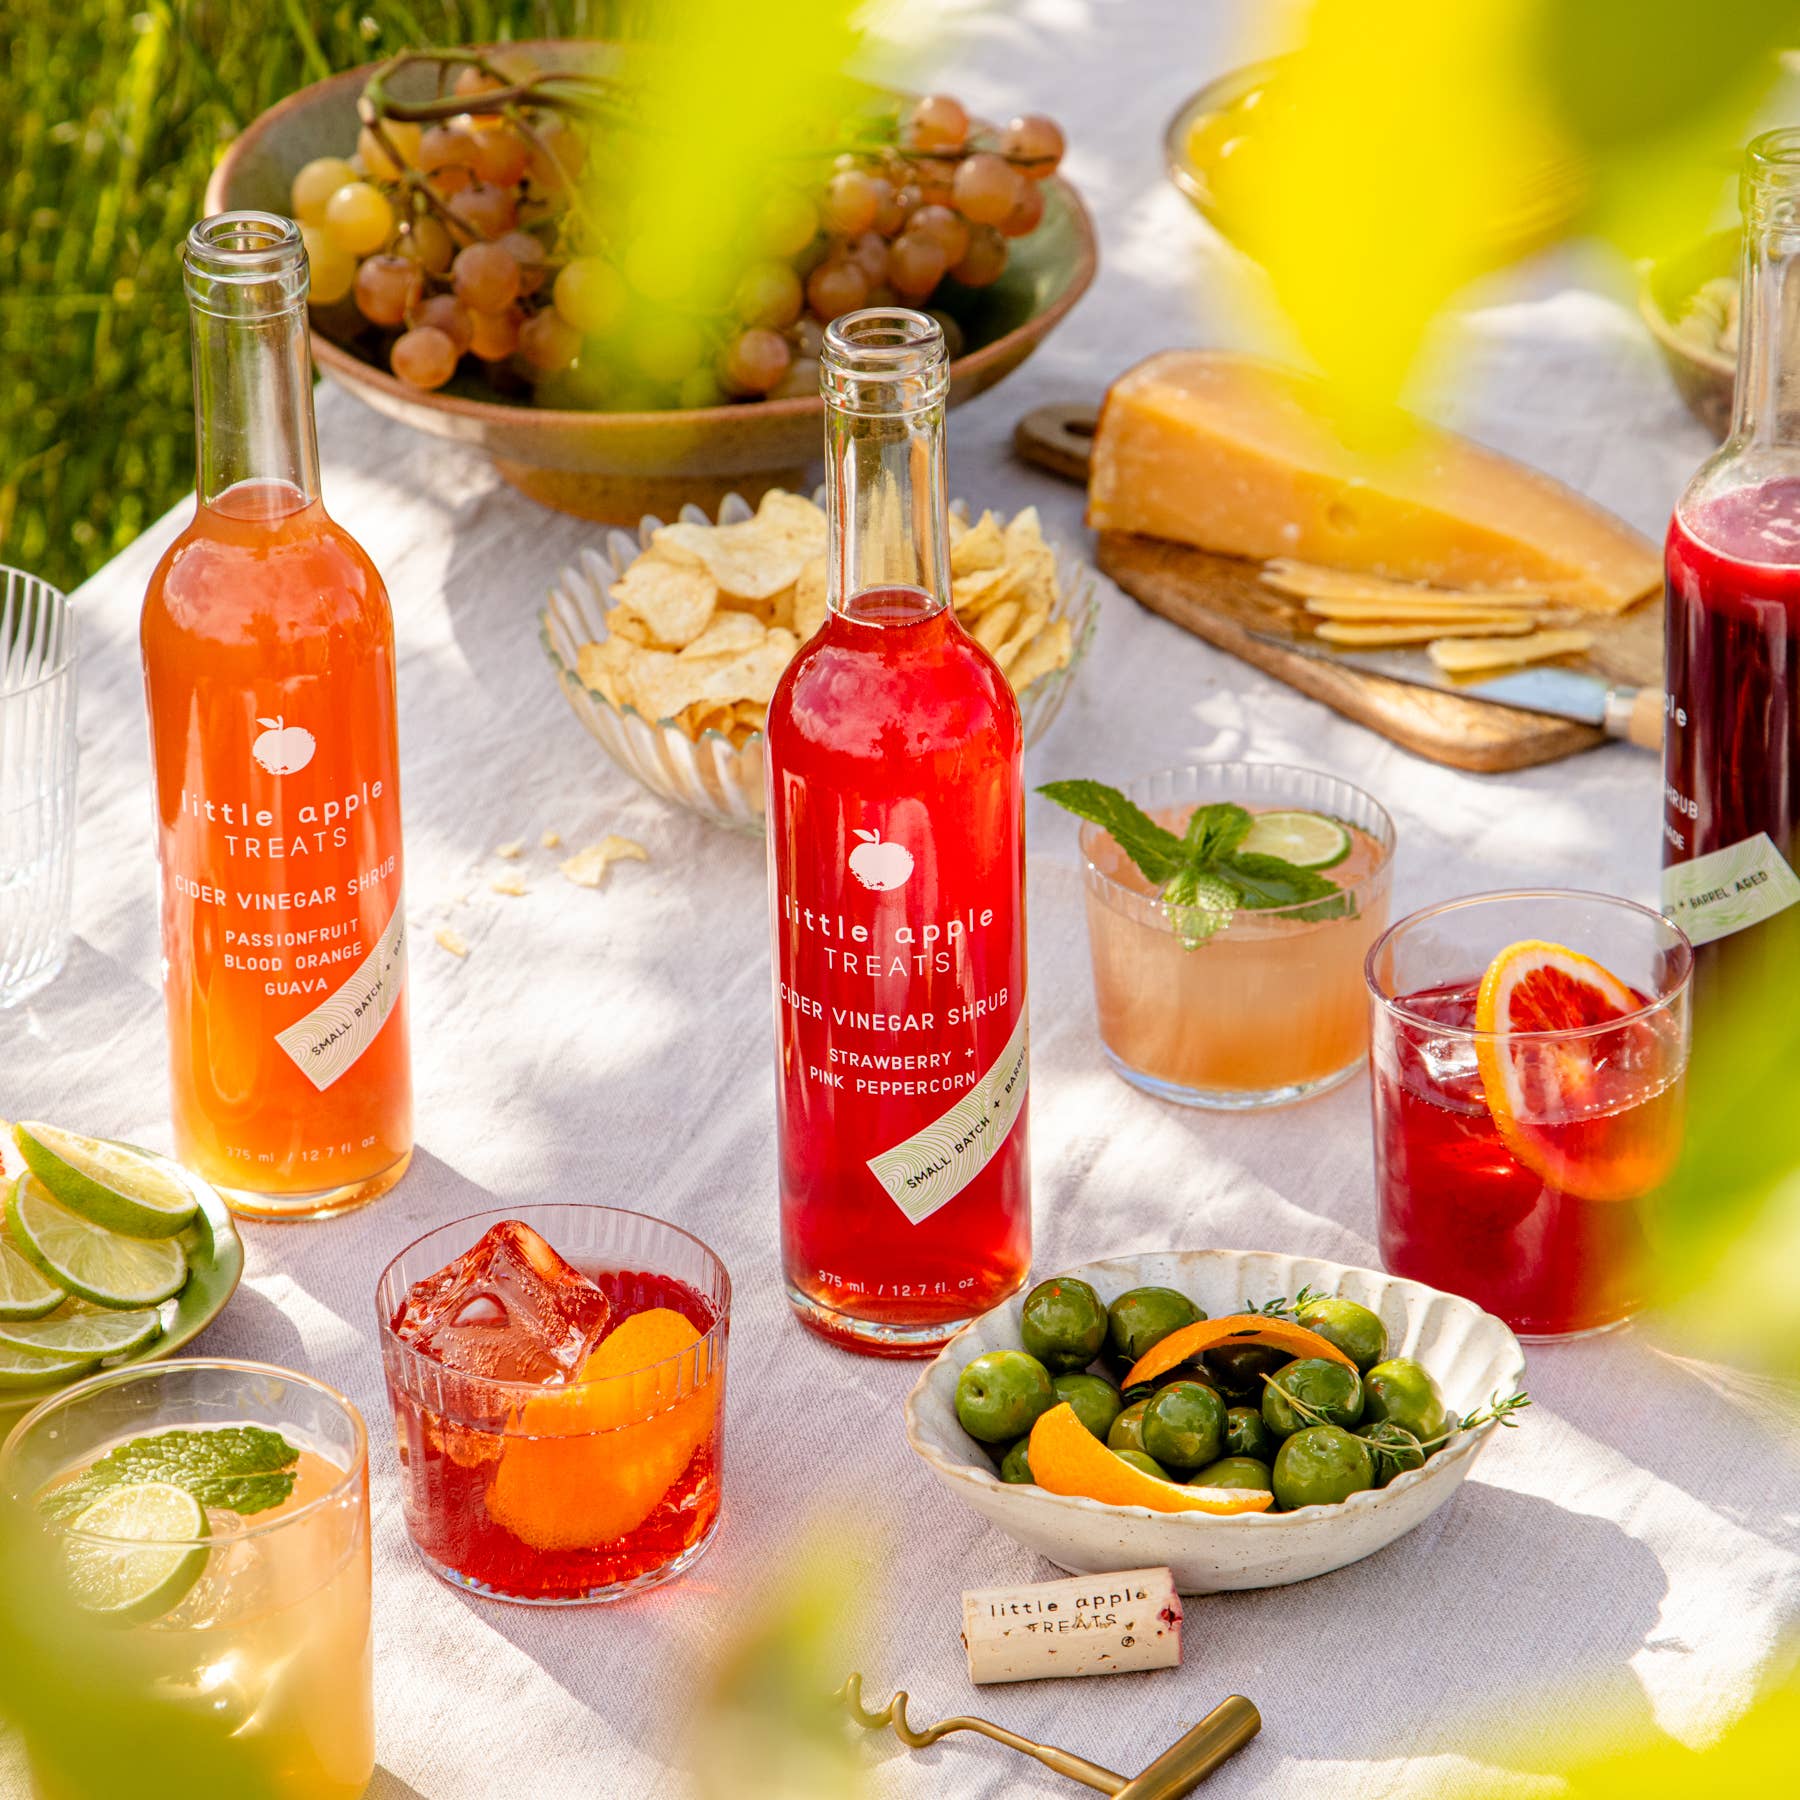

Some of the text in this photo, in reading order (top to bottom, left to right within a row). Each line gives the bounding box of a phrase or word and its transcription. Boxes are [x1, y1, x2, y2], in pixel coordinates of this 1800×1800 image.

[182, 780, 382, 826] little apple
[224, 827, 346, 858] TREATS
[175, 855, 395, 910] CIDER VINEGAR SHRUB
[1690, 887, 1730, 909] BARREL
[1735, 870, 1768, 892] AGED
[225, 918, 359, 947] PASSIONFRUIT
[785, 894, 993, 949] little apple
[224, 941, 362, 971] BLOOD ORANGE
[824, 947, 950, 977] TREATS
[265, 978, 328, 996] GUAVA
[311, 1022, 352, 1056] SMALL
[354, 980, 384, 1017] BATCH
[780, 981, 1008, 1031] CIDER VINEGAR SHRUB
[829, 1047, 952, 1070] STRAWBERRY
[810, 1066, 976, 1096] PINK PEPPERCORN
[906, 1156, 952, 1189] SMALL
[954, 1116, 990, 1153] BATCH
[818, 1270, 843, 1288] 375
[849, 1281, 870, 1295] ml.
[892, 1283, 927, 1297] 12.7
[935, 1281, 951, 1294] fl.
[958, 1277, 979, 1289] oz.
[991, 1589, 1148, 1617] little apple
[1026, 1614, 1117, 1634] TREATS
